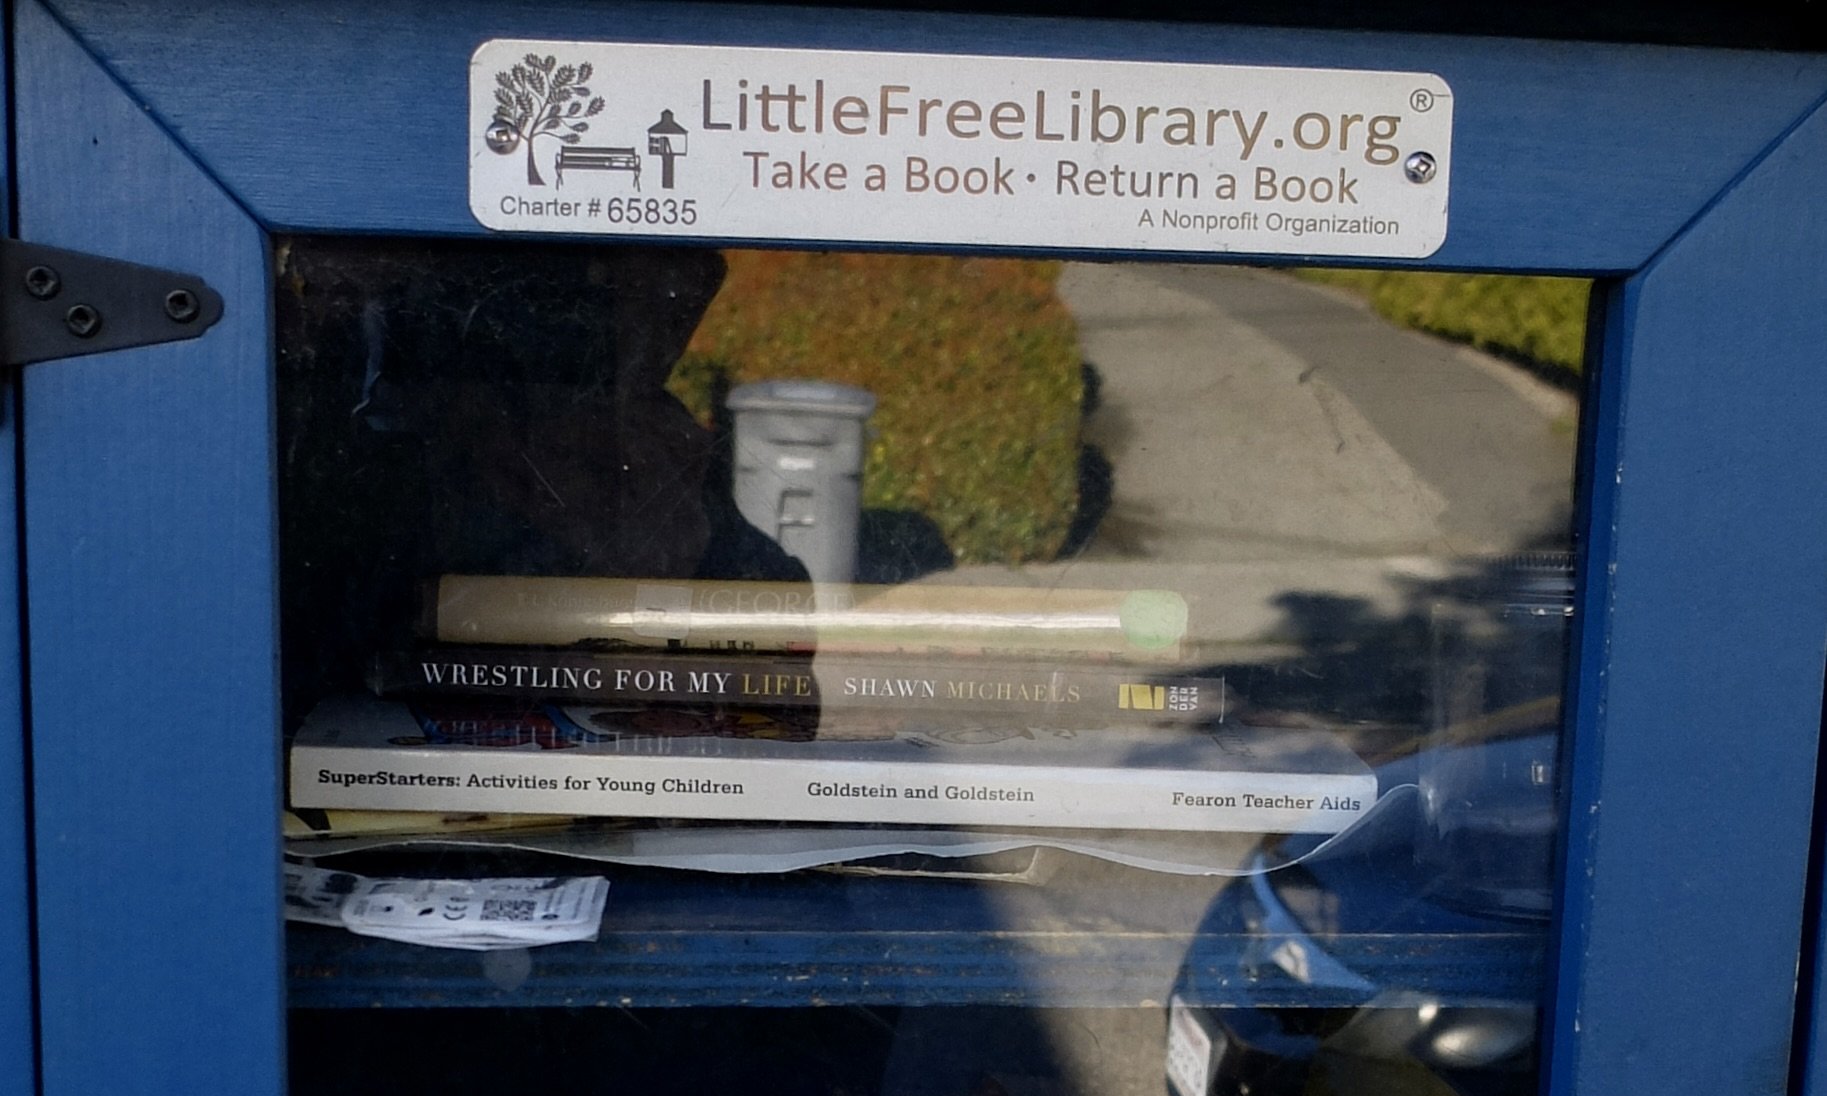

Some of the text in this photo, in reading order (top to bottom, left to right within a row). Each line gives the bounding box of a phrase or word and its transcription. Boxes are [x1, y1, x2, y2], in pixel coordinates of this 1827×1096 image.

[703, 79, 1401, 165] LittleFreeLibrary.org
[743, 151, 1358, 203] Take a Book Return a Book
[500, 196, 697, 224] Charter # 65835
[1138, 209, 1399, 236] A Nonprofit Organization
[422, 663, 1081, 703] WRESTLING FOR MY LIFE SHAWN MICHAELS
[1169, 686, 1178, 711] ZON
[1179, 686, 1188, 711] DER
[1189, 686, 1198, 711] VAN
[318, 769, 1361, 812] SuperStarters: Activities for Young Children Goldstein and Goldstein Fearon Teacher Aids
